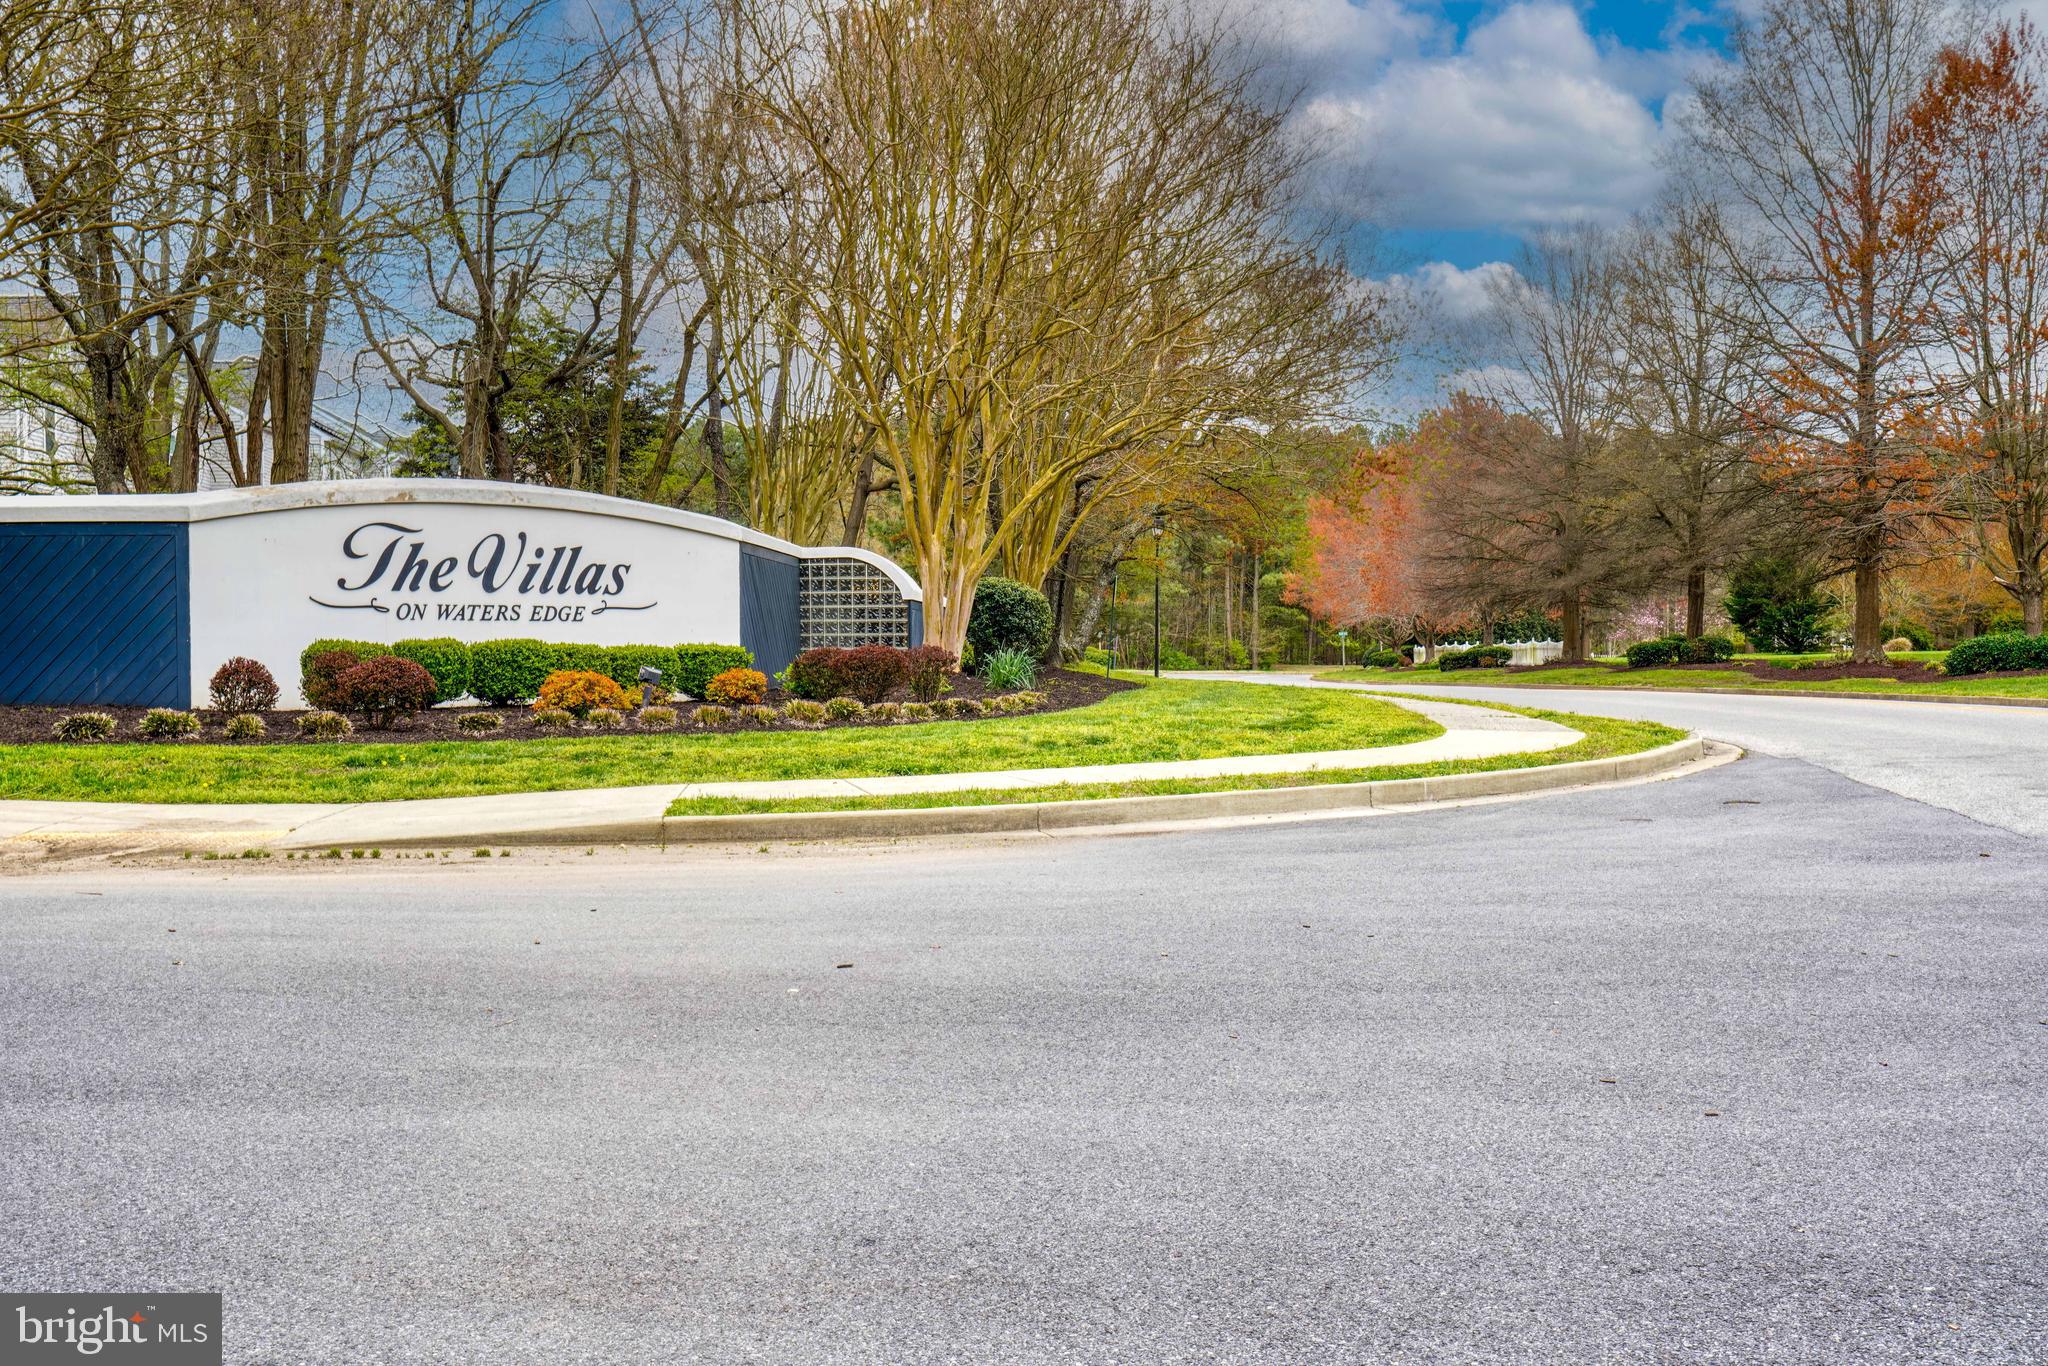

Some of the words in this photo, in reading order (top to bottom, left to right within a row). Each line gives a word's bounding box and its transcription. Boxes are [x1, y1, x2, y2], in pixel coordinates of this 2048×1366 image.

[337, 522, 459, 591] The
[467, 531, 632, 595] Villas
[396, 603, 426, 621] ON
[437, 604, 521, 622] WATERS
[529, 605, 587, 622] EDGE
